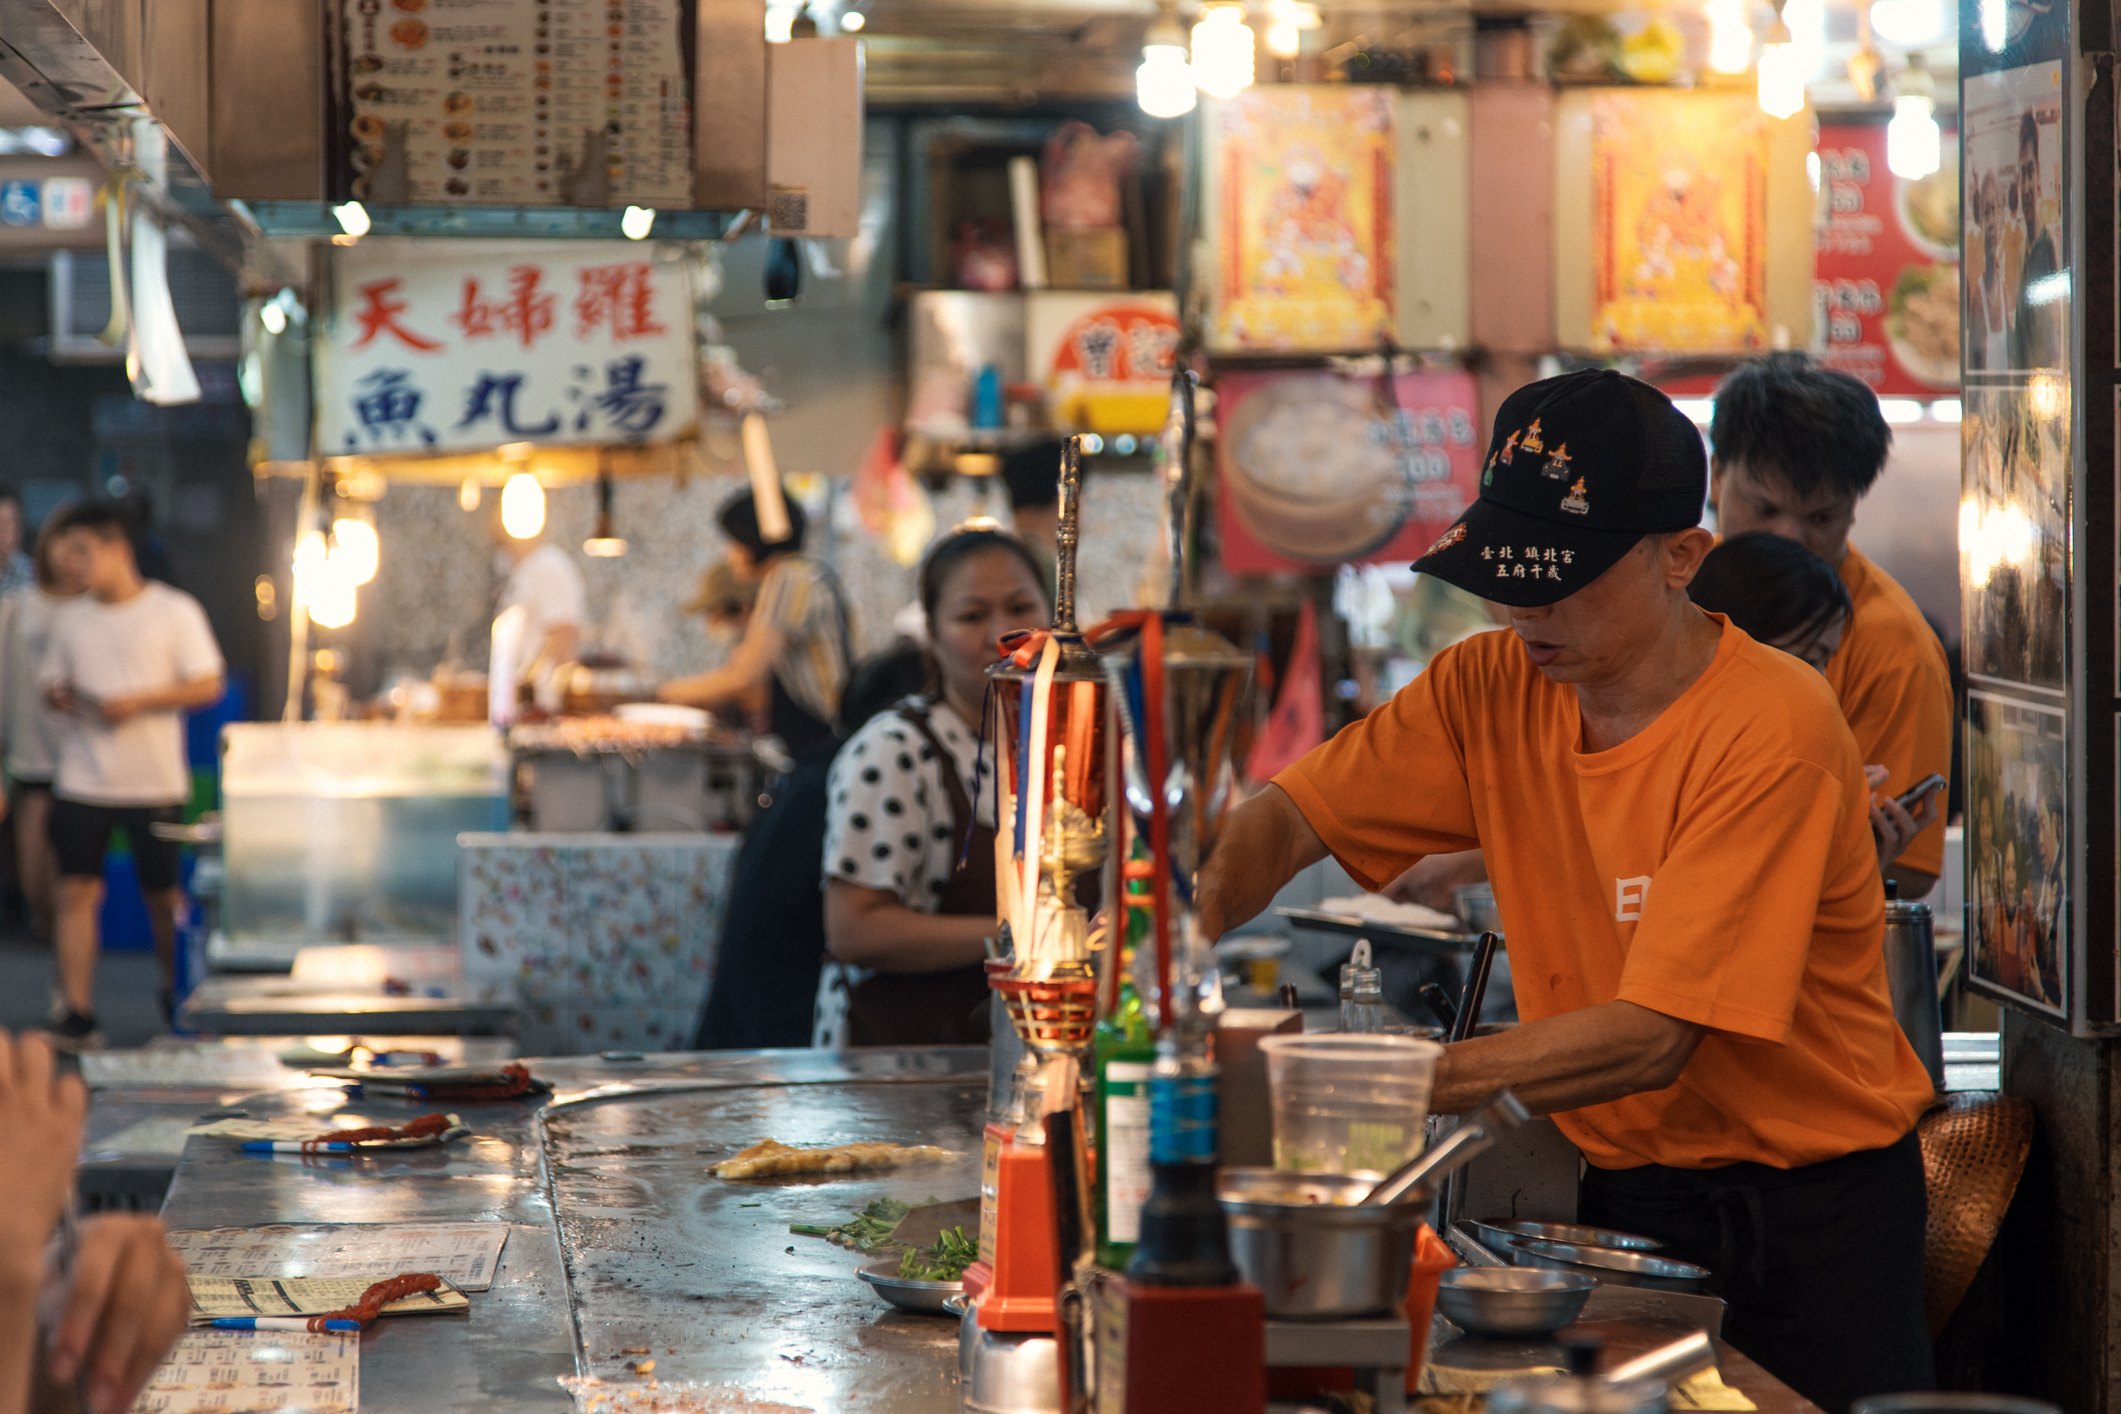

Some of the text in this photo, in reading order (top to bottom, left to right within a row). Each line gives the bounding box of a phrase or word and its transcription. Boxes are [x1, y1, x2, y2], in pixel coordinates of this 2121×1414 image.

[351, 262, 667, 355] 天婦羅
[344, 354, 668, 447] 魚丸湯
